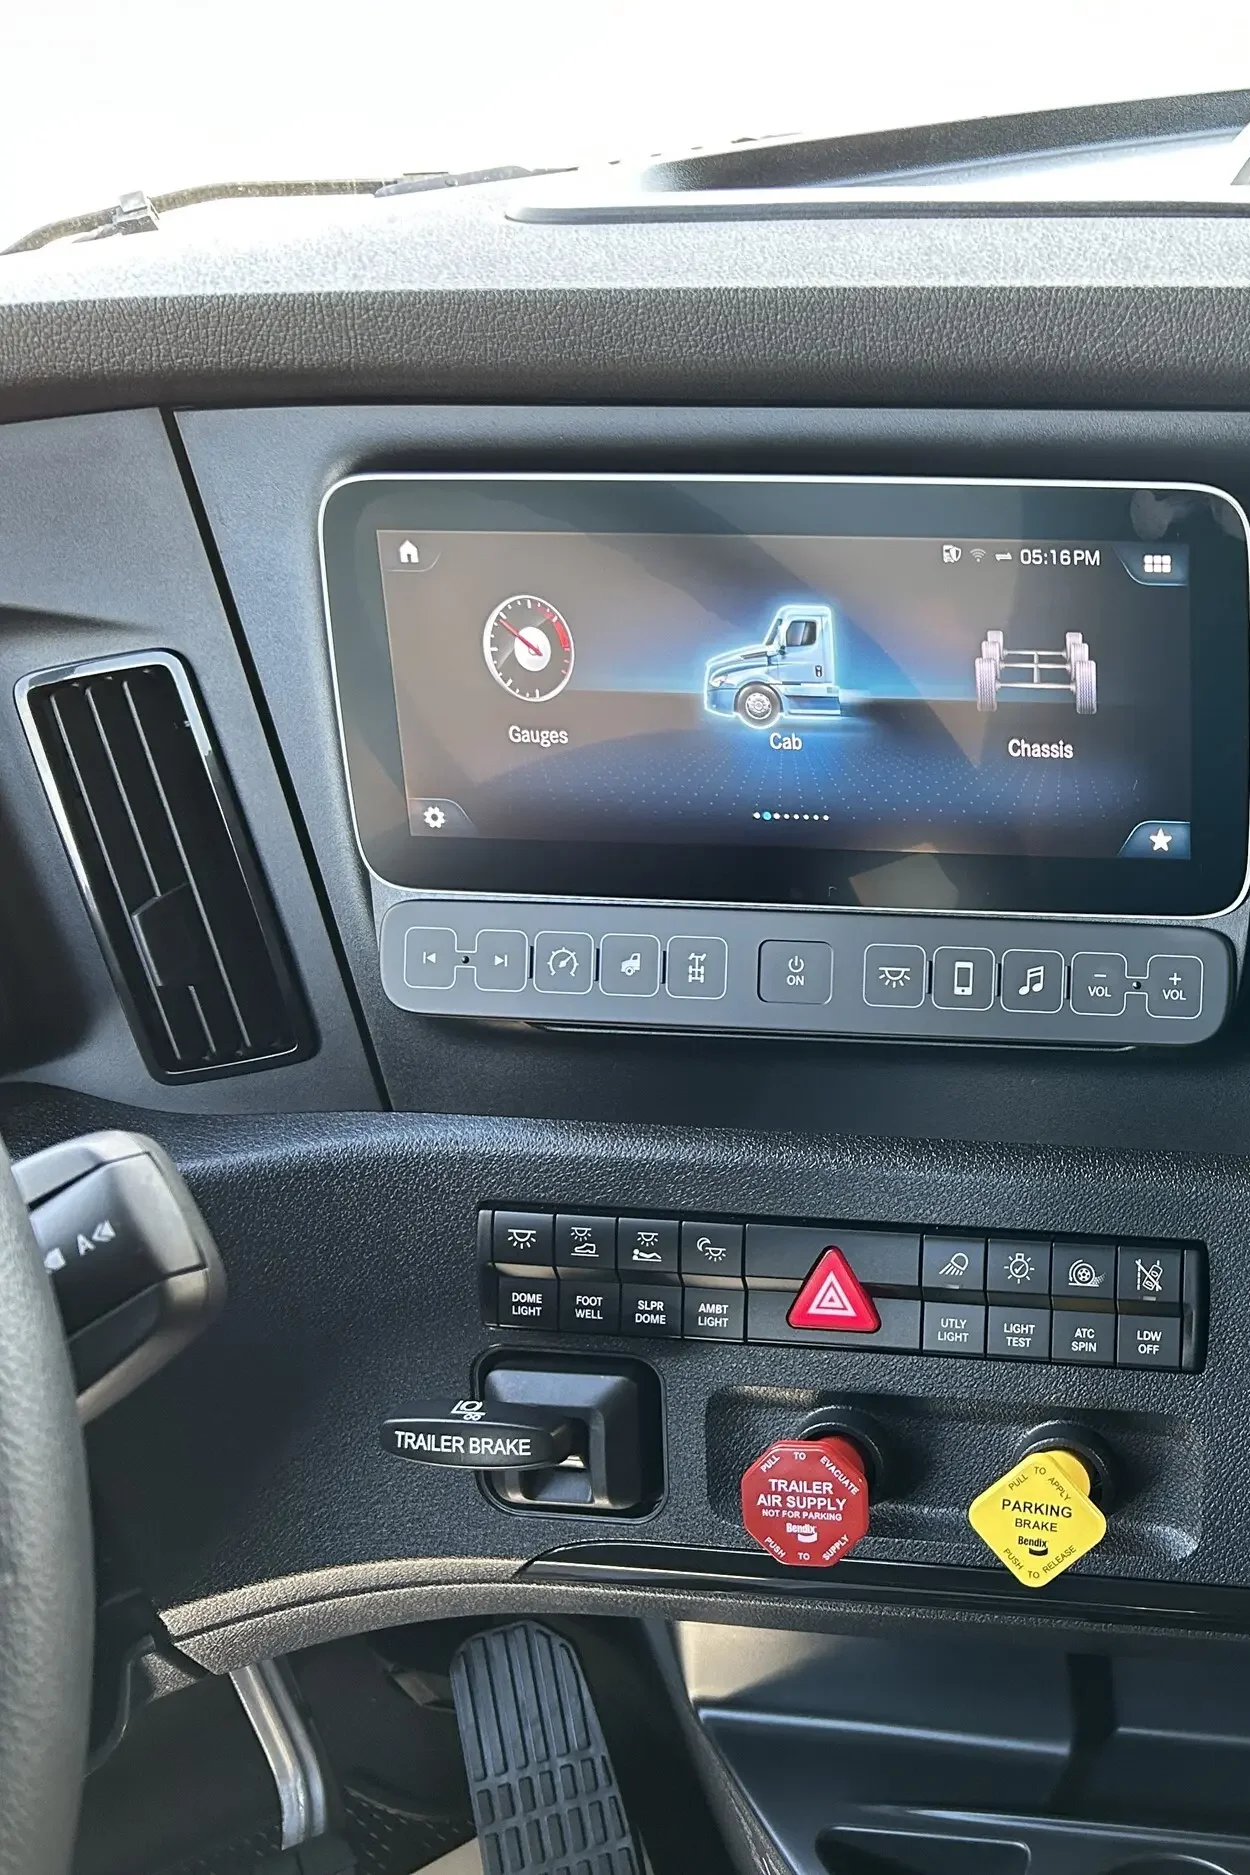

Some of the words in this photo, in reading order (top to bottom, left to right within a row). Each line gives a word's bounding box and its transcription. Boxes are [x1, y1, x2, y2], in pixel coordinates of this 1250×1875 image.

[508, 725, 569, 748] Gauges
[769, 732, 803, 751] Cab
[1007, 738, 1074, 759] Chassis
[786, 974, 805, 986] ON
[1087, 985, 1112, 998] VOL
[1162, 988, 1187, 1002] VOL
[511, 1292, 543, 1304] DOME
[575, 1295, 603, 1307] FOOT
[511, 1305, 542, 1317] LIGHT
[637, 1299, 665, 1312] SLPR
[698, 1302, 729, 1315] AMBT
[575, 1308, 603, 1320] WELL
[635, 1313, 667, 1325] DOME
[697, 1315, 729, 1328] LIGHT
[940, 1318, 967, 1330] UTLY
[1003, 1322, 1035, 1335] LIGHT
[1074, 1327, 1095, 1340] ATC
[937, 1331, 969, 1343] LIGHT
[1005, 1336, 1032, 1348] TEST
[1136, 1329, 1162, 1342] LDW
[1071, 1340, 1097, 1353] SPIN
[1137, 1343, 1160, 1356] OFF
[394, 1430, 465, 1454] TRAILER
[469, 1437, 532, 1456] BRAKE
[760, 1454, 781, 1472] PULL
[793, 1451, 807, 1461] TO
[819, 1455, 860, 1496] EVACUATE
[768, 1478, 834, 1495] TRAILER
[1008, 1473, 1029, 1492] PULL
[1033, 1466, 1047, 1476] TO
[1047, 1476, 1072, 1502] APPLY
[756, 1494, 783, 1508] AIR
[786, 1495, 847, 1511] SUPPLY
[1001, 1498, 1073, 1519] PARKING
[761, 1509, 781, 1518] NOT
[782, 1510, 800, 1519] FOR
[802, 1511, 843, 1521] PARKING
[785, 1522, 816, 1534] Bendix
[1014, 1518, 1058, 1533] BRAKE
[764, 1536, 786, 1559] PUSH
[797, 1552, 811, 1561] TO
[822, 1534, 850, 1561] SUPPLY
[1018, 1535, 1048, 1548] Bendix
[1003, 1547, 1025, 1571] PUSH
[1027, 1570, 1040, 1579] TO
[1042, 1544, 1077, 1574] RELEASE
